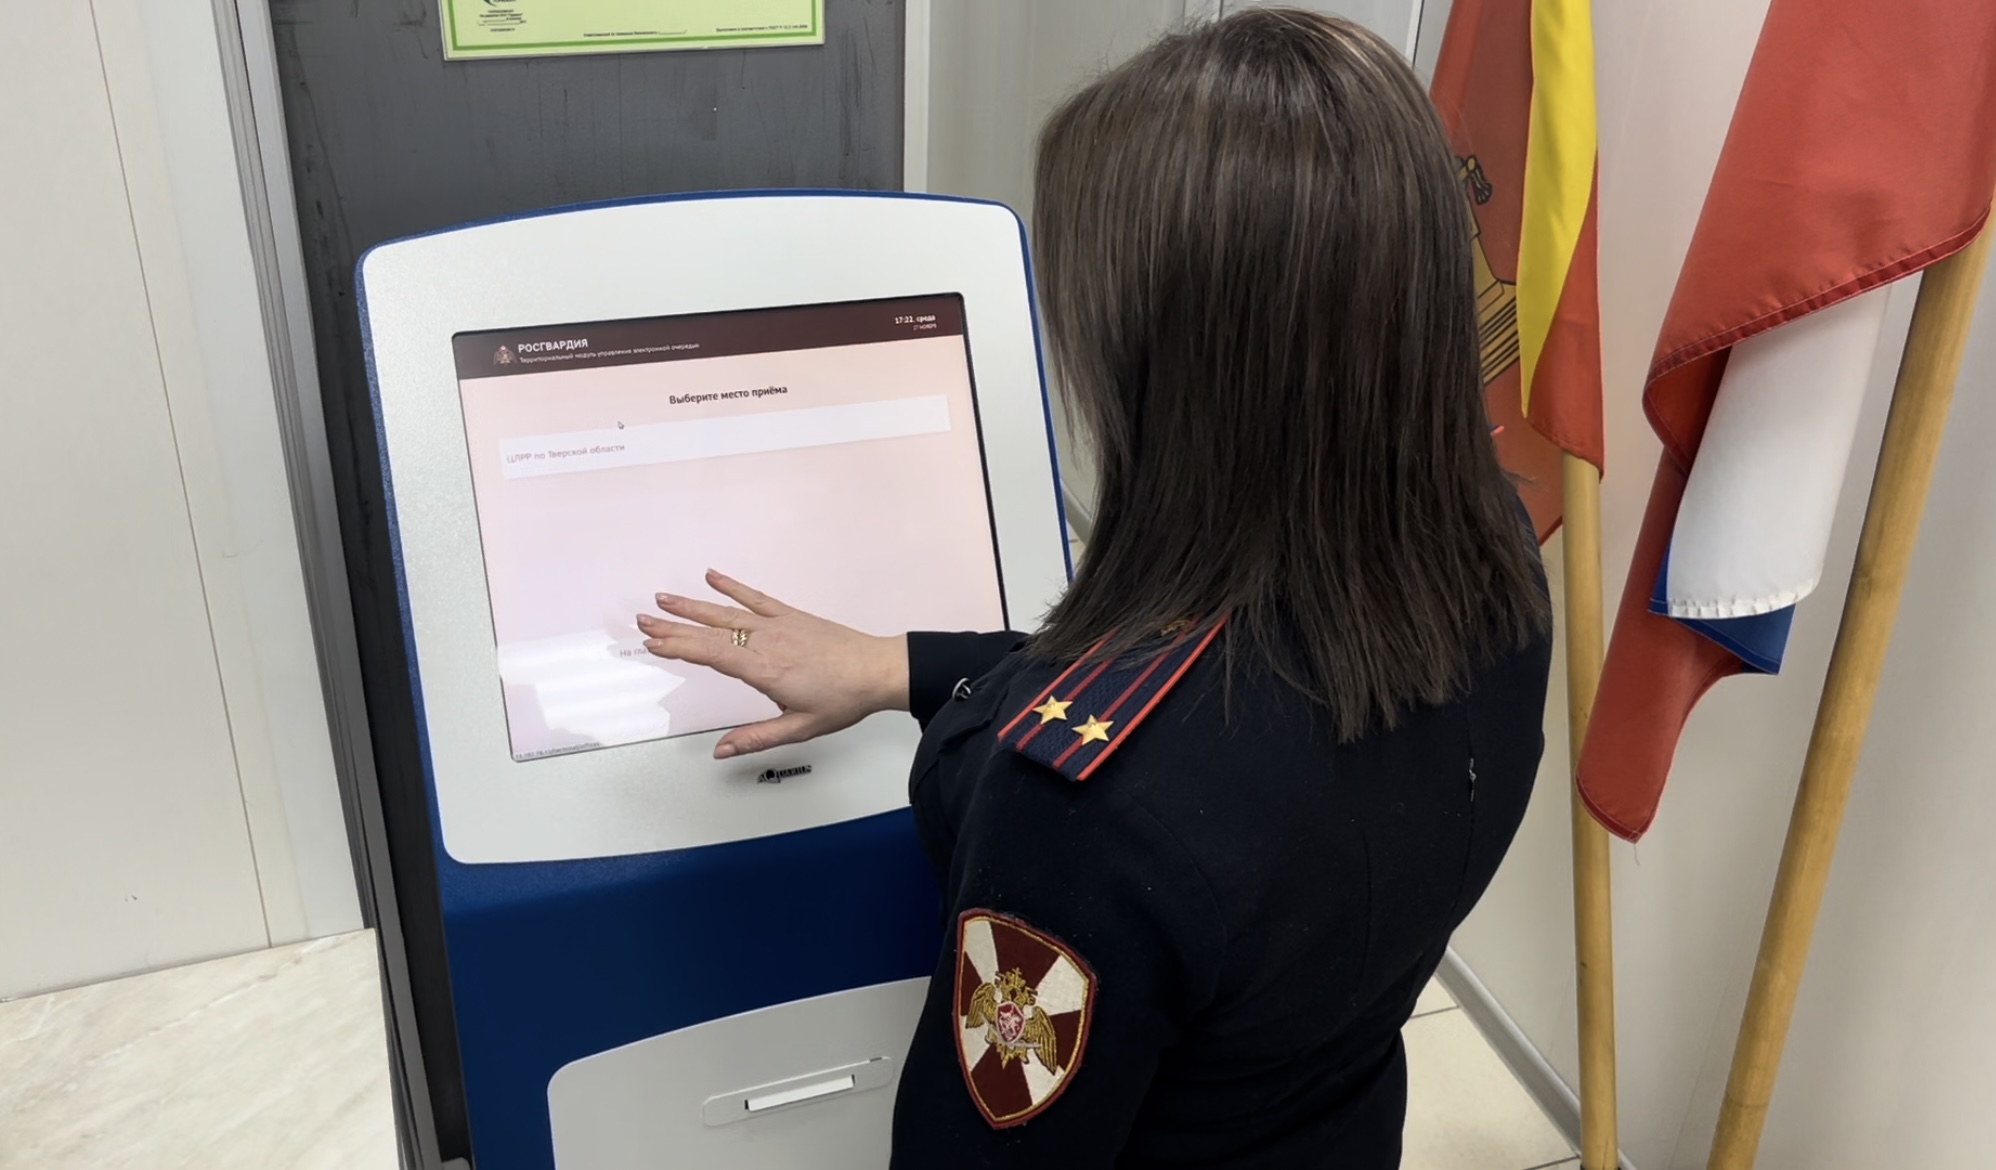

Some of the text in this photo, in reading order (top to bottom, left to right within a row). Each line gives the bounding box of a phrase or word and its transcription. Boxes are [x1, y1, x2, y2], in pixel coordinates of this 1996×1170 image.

[916, 314, 936, 323] среда
[517, 338, 589, 353] РОСГВАРДИЯ
[520, 342, 700, 364] Территориальный модуль управления электронной очередью
[669, 385, 788, 405] Выберите место приёма
[547, 447, 588, 459] Тверской
[589, 444, 625, 455] области
[620, 649, 632, 657] На
